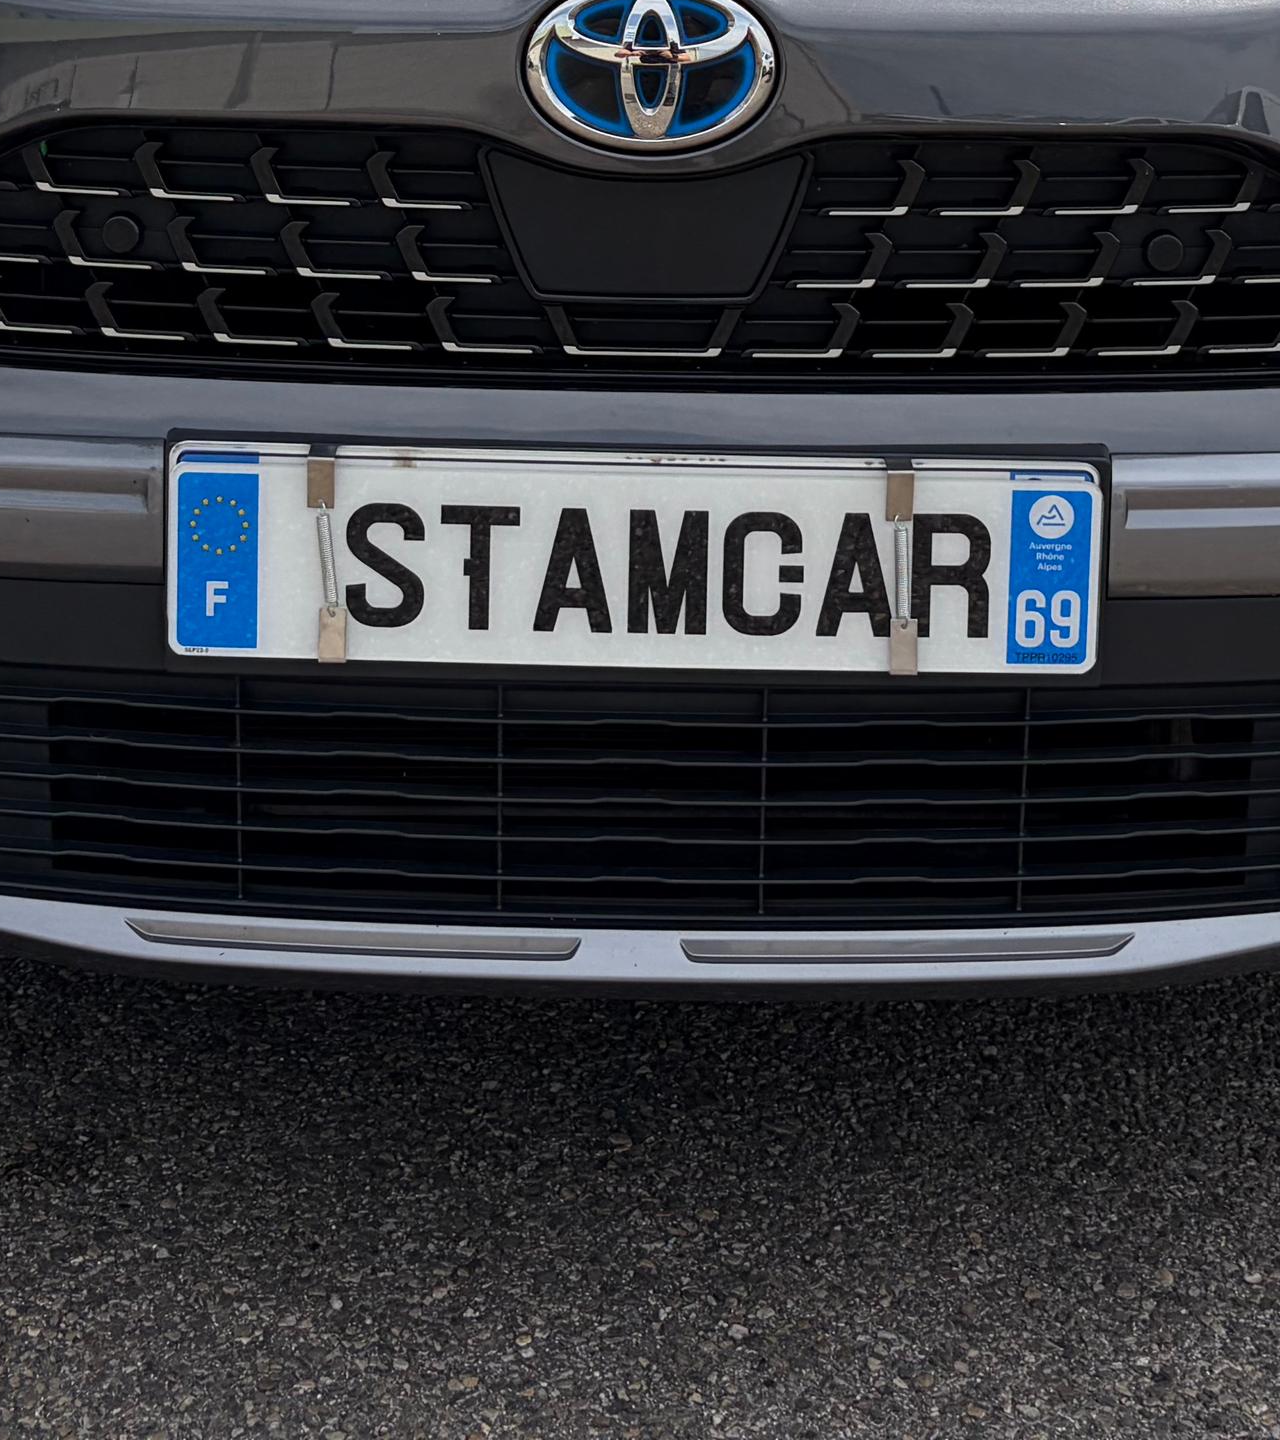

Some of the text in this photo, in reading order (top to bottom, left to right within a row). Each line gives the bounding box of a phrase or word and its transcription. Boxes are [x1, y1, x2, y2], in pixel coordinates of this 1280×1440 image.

[1029, 541, 1072, 552] Auvergne
[1035, 552, 1064, 561] Rhône
[345, 502, 992, 638] STAMCAR
[1037, 563, 1062, 572] Alpes
[206, 581, 229, 616] F
[1015, 589, 1081, 648] 69
